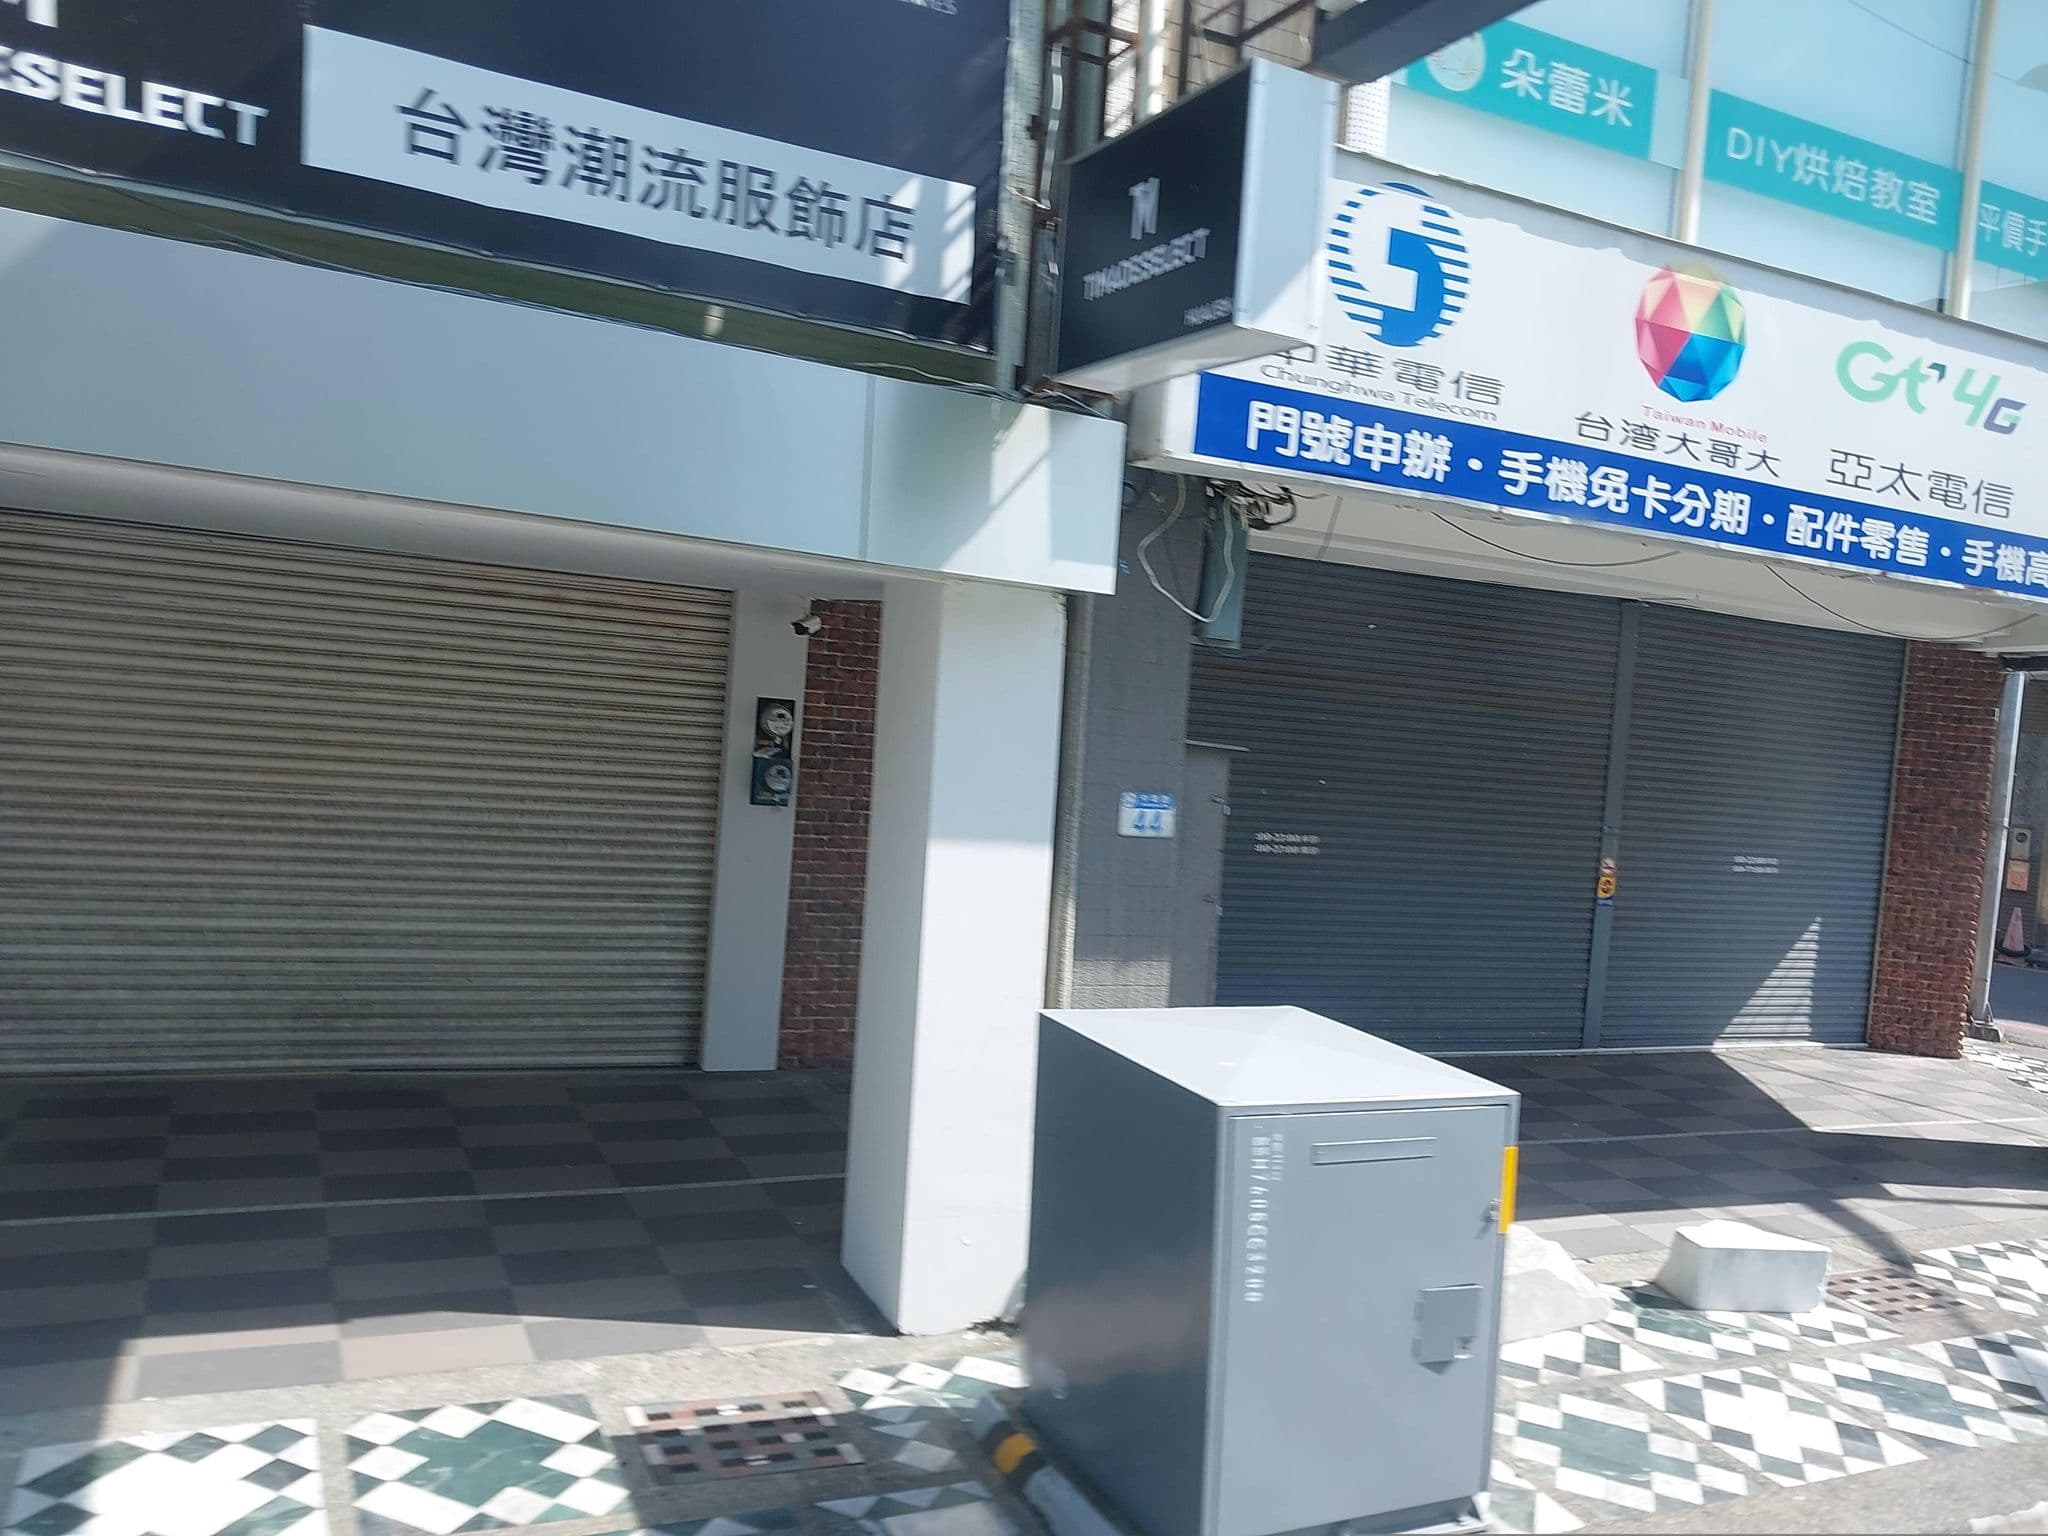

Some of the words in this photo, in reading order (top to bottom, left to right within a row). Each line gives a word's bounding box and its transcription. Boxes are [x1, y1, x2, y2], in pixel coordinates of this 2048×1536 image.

[1500, 48, 1633, 129] 朵蕾米
[394, 88, 915, 262] 台灣潮流服飾店
[1726, 127, 1942, 226] DIY烘焙教室
[1259, 363, 1395, 401] Chunghwa
[1401, 391, 1498, 422] Telecom
[1642, 404, 1707, 431] Taiwan
[1710, 420, 1768, 443] Mobile
[1826, 448, 2015, 519] 亞太電信
